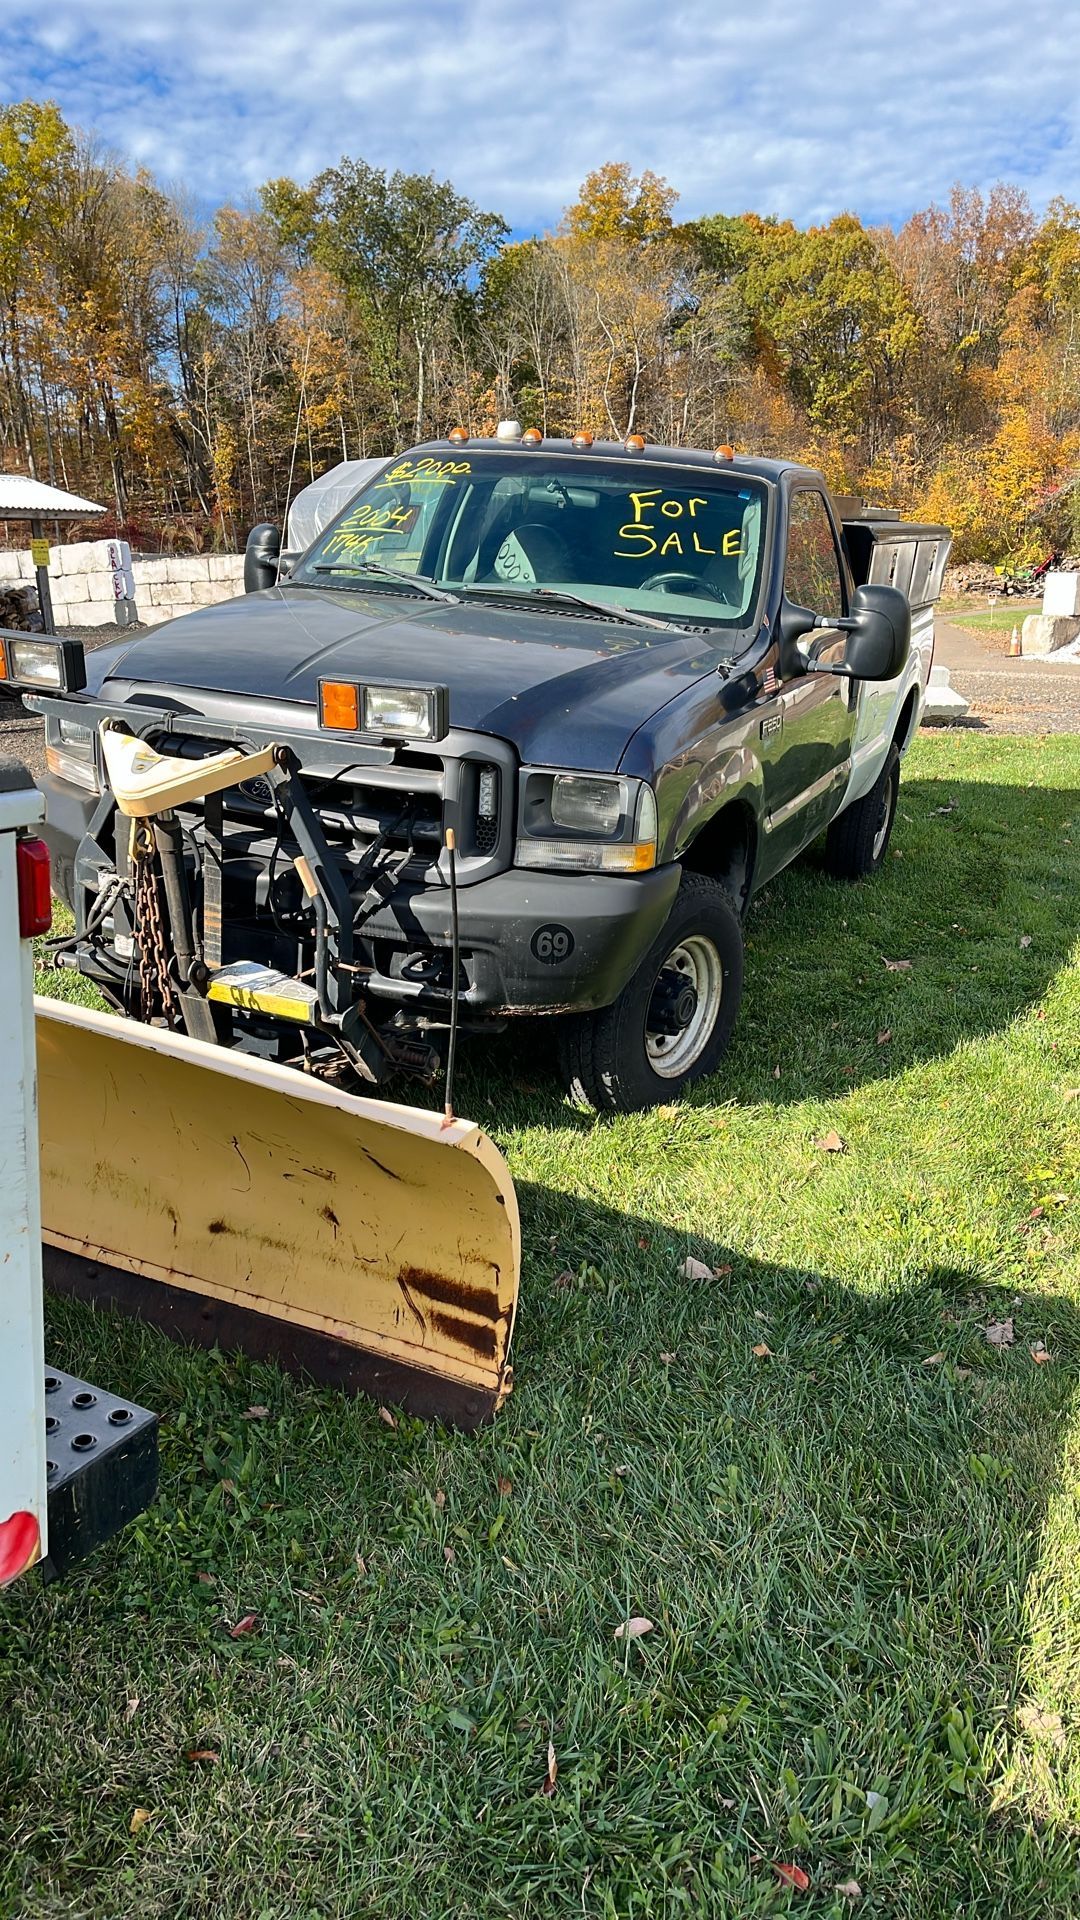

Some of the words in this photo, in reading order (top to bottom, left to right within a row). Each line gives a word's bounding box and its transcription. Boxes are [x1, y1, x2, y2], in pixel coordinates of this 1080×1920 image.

[340, 505, 413, 526] 2004
[629, 489, 708, 522] For
[613, 524, 745, 557] SALE
[536, 931, 568, 957] 69
